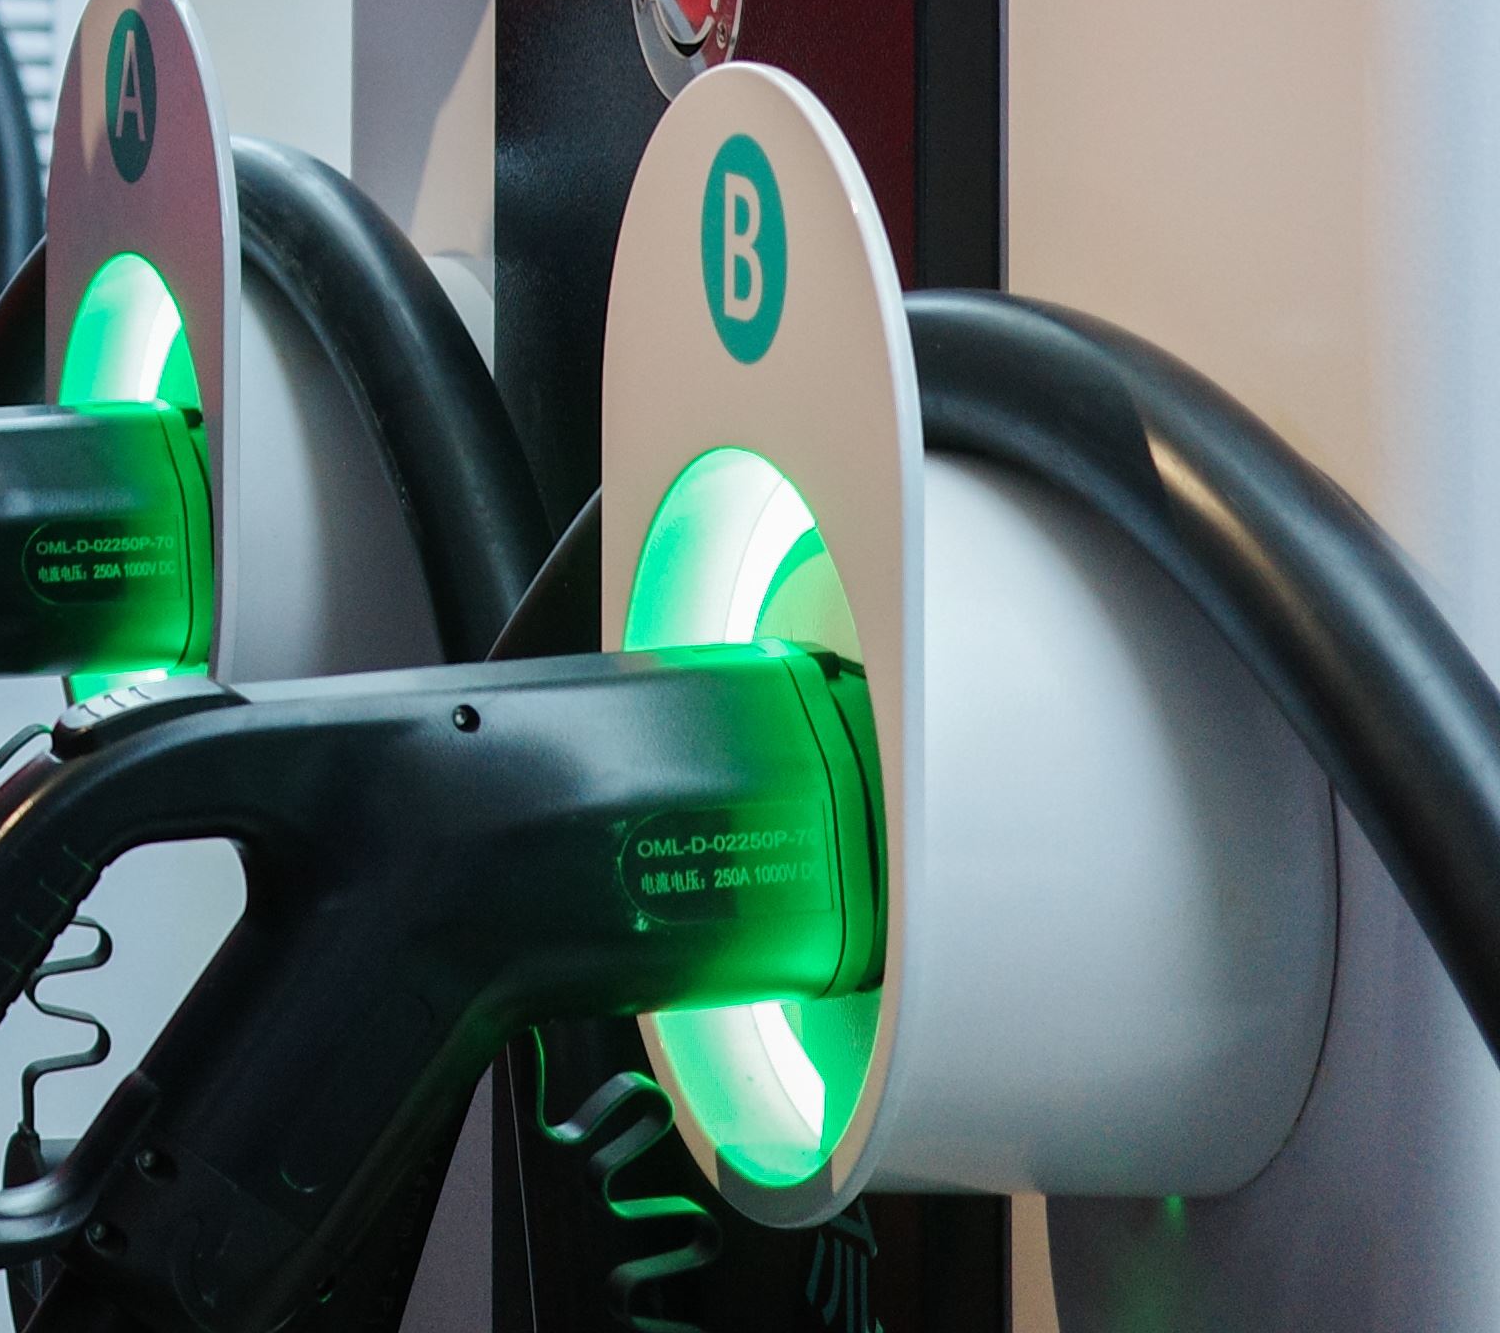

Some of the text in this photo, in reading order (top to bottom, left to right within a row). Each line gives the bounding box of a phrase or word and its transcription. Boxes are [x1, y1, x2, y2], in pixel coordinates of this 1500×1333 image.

[114, 28, 147, 142] A
[722, 171, 764, 323] B
[93, 563, 121, 579] 250A
[123, 561, 157, 577] 1000V
[159, 560, 176, 575] DC
[713, 866, 751, 889] 250A
[754, 863, 798, 884] 1000V
